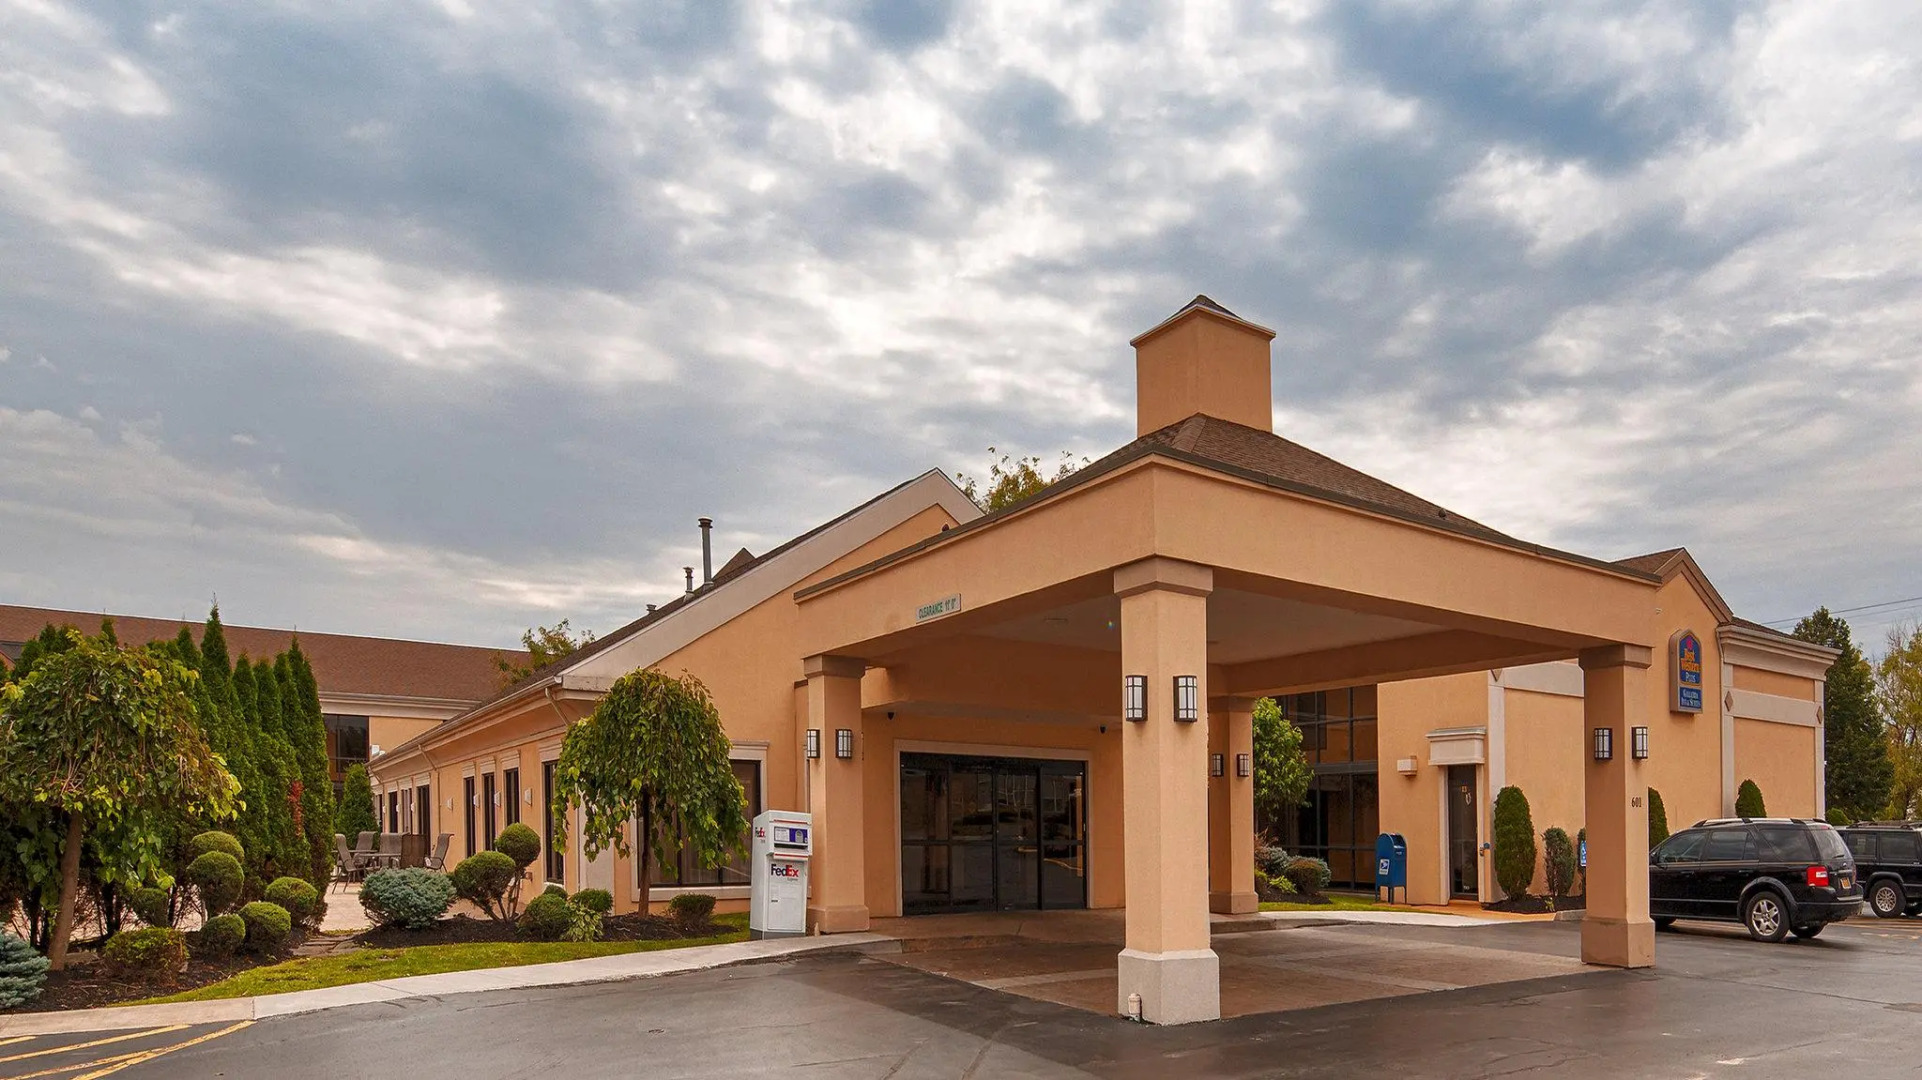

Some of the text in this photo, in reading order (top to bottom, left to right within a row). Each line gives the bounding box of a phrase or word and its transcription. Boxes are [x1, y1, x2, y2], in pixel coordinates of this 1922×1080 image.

[919, 602, 943, 619] CLEARANCE
[1631, 796, 1642, 808] 601
[771, 863, 799, 877] FedEx
